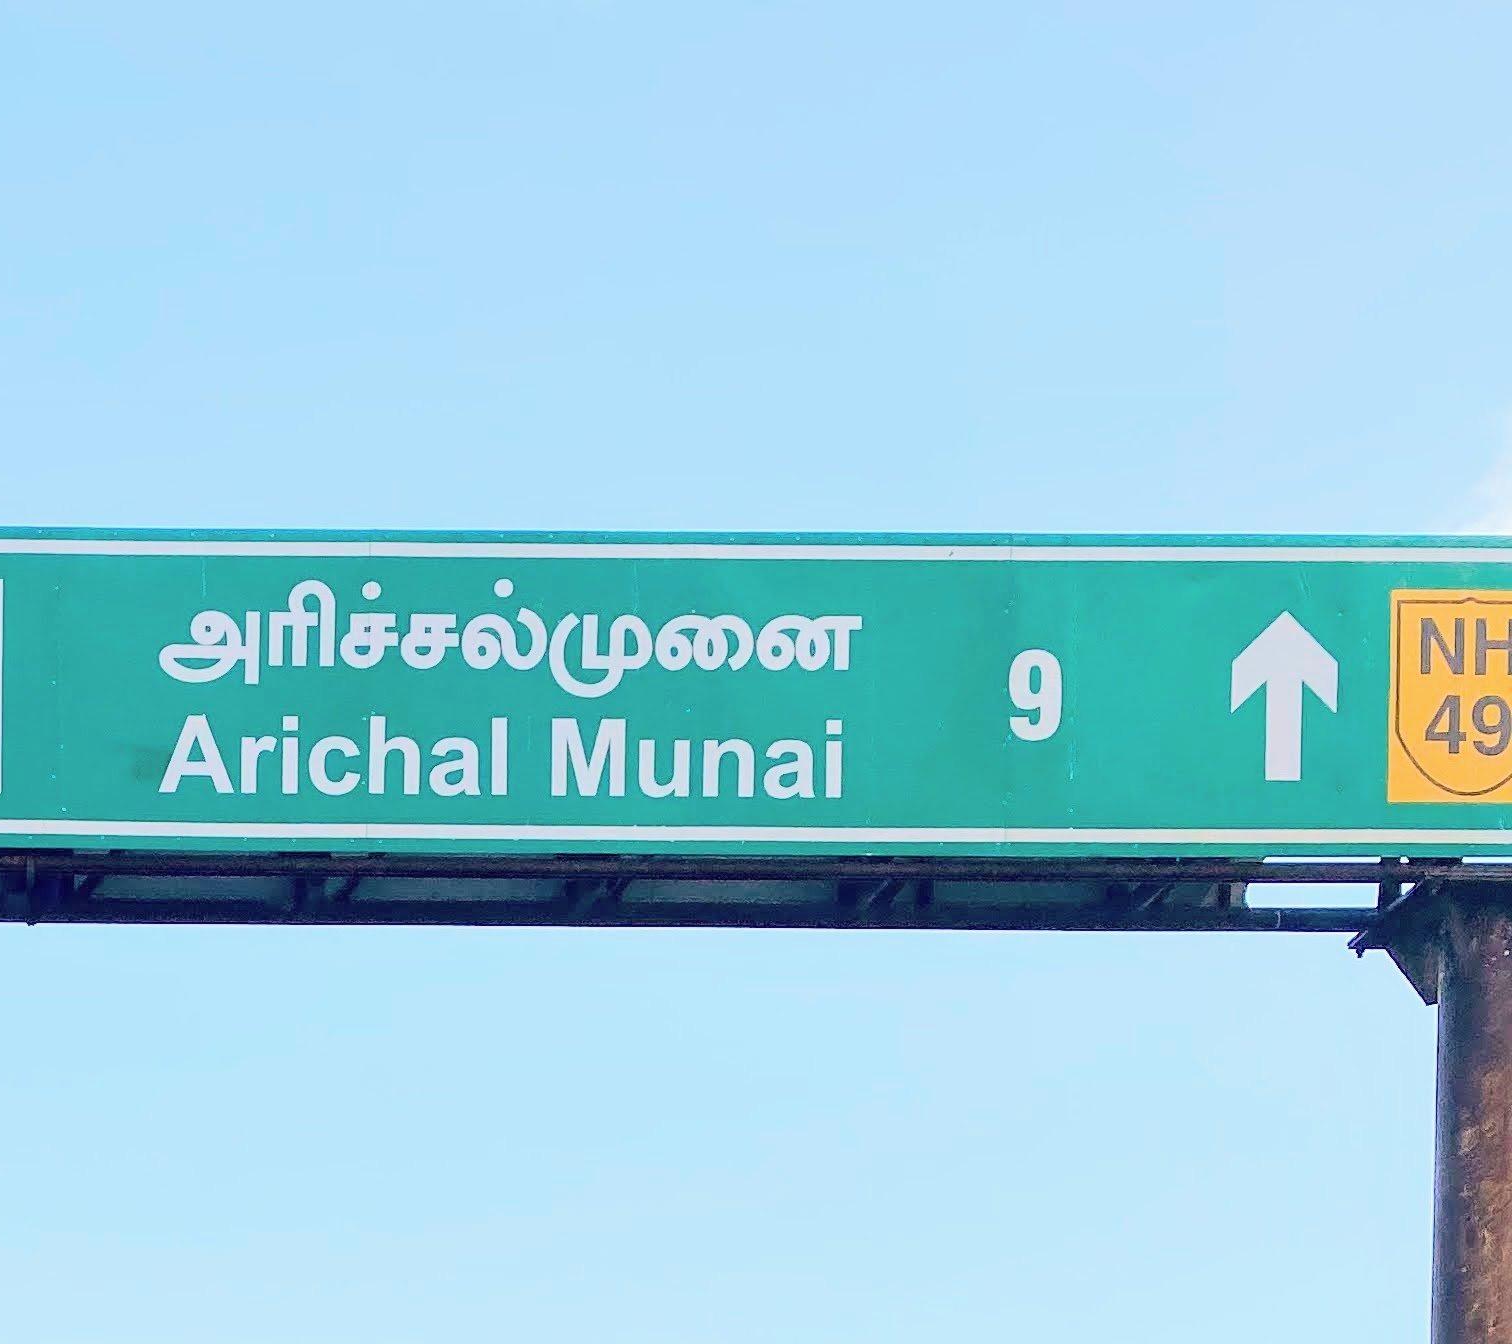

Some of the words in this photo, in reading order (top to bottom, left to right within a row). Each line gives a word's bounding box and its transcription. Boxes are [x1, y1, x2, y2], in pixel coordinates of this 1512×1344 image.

[159, 579, 862, 698] அரிச்சல்முனை
[1420, 617, 1512, 676] NH
[1008, 649, 1062, 741] 9
[1424, 694, 1512, 757] 49
[159, 715, 508, 797] Arichal
[551, 718, 843, 799] Munai
